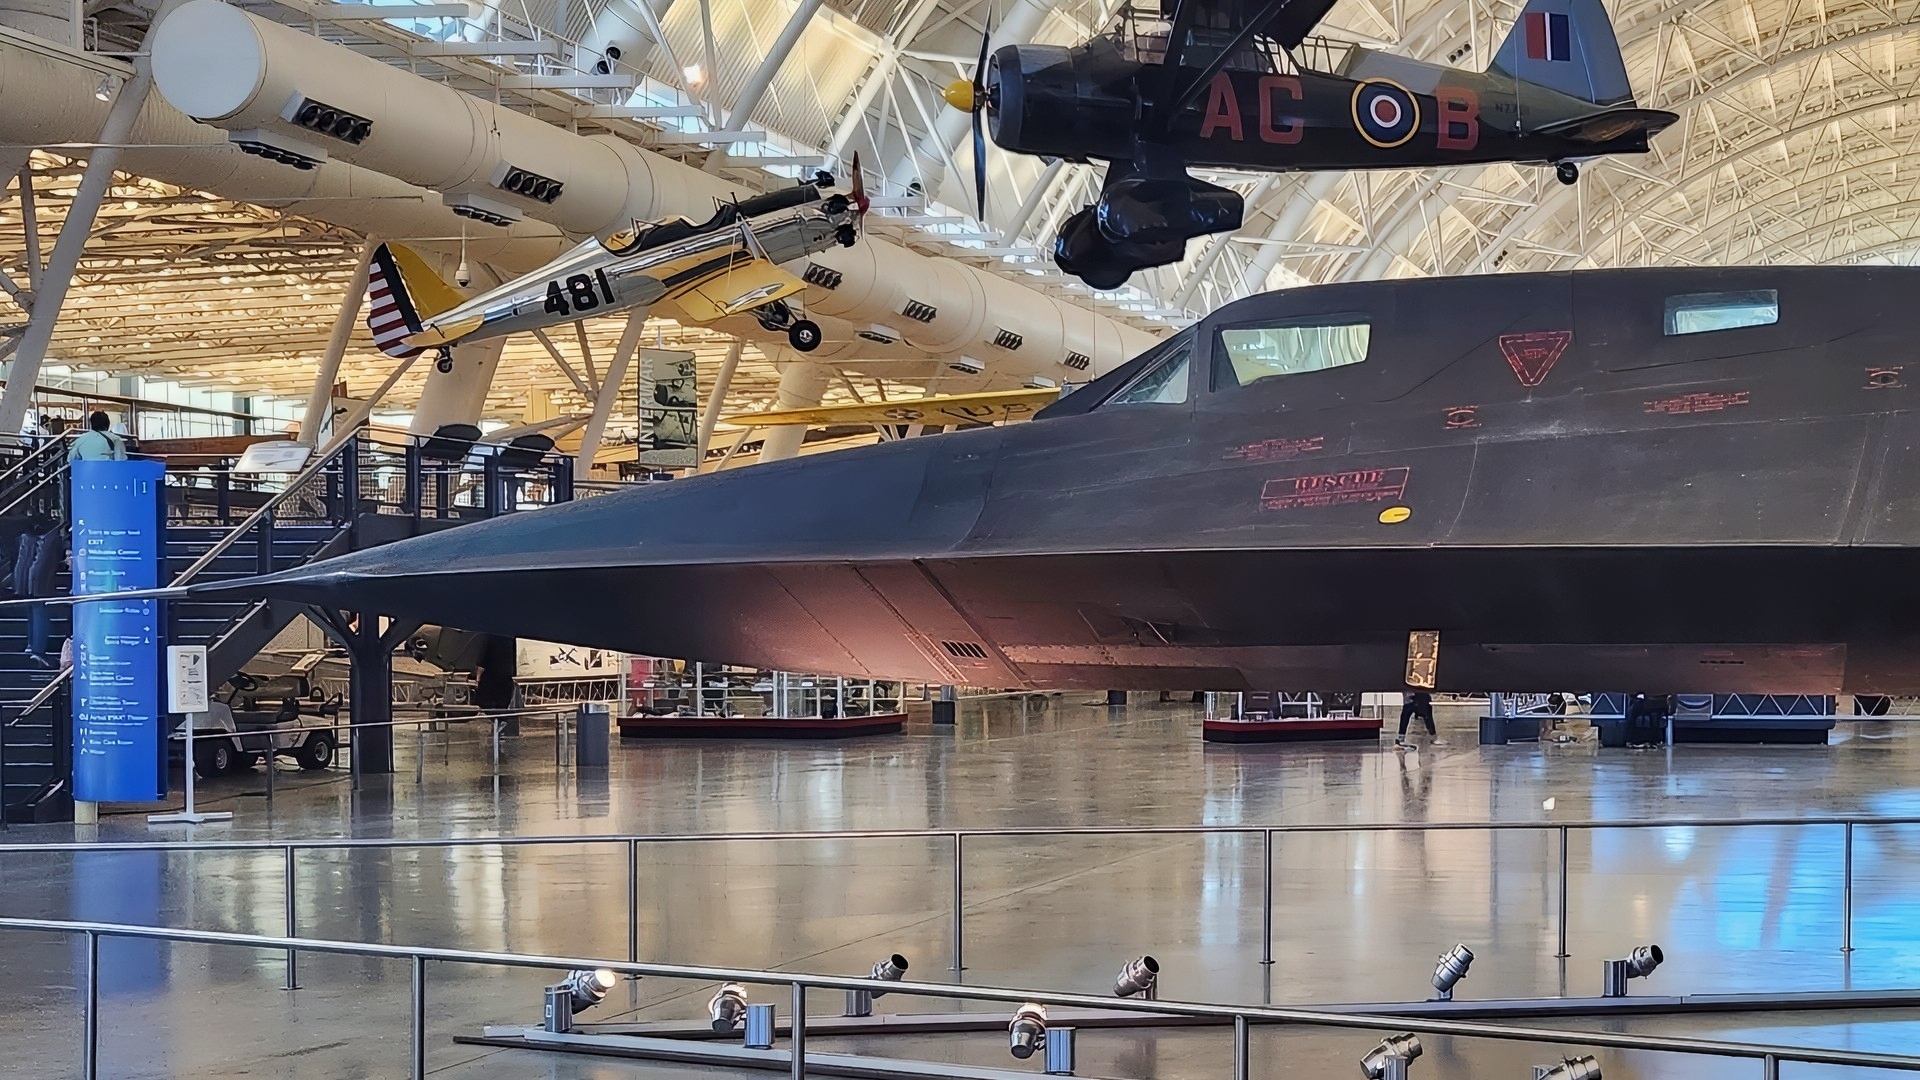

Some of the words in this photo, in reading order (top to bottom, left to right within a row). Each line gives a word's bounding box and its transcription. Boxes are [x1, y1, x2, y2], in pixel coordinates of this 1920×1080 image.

[1200, 71, 1304, 145] AC
[1436, 86, 1481, 151] B
[543, 267, 616, 316] 481
[639, 359, 655, 449] INTERWAR
